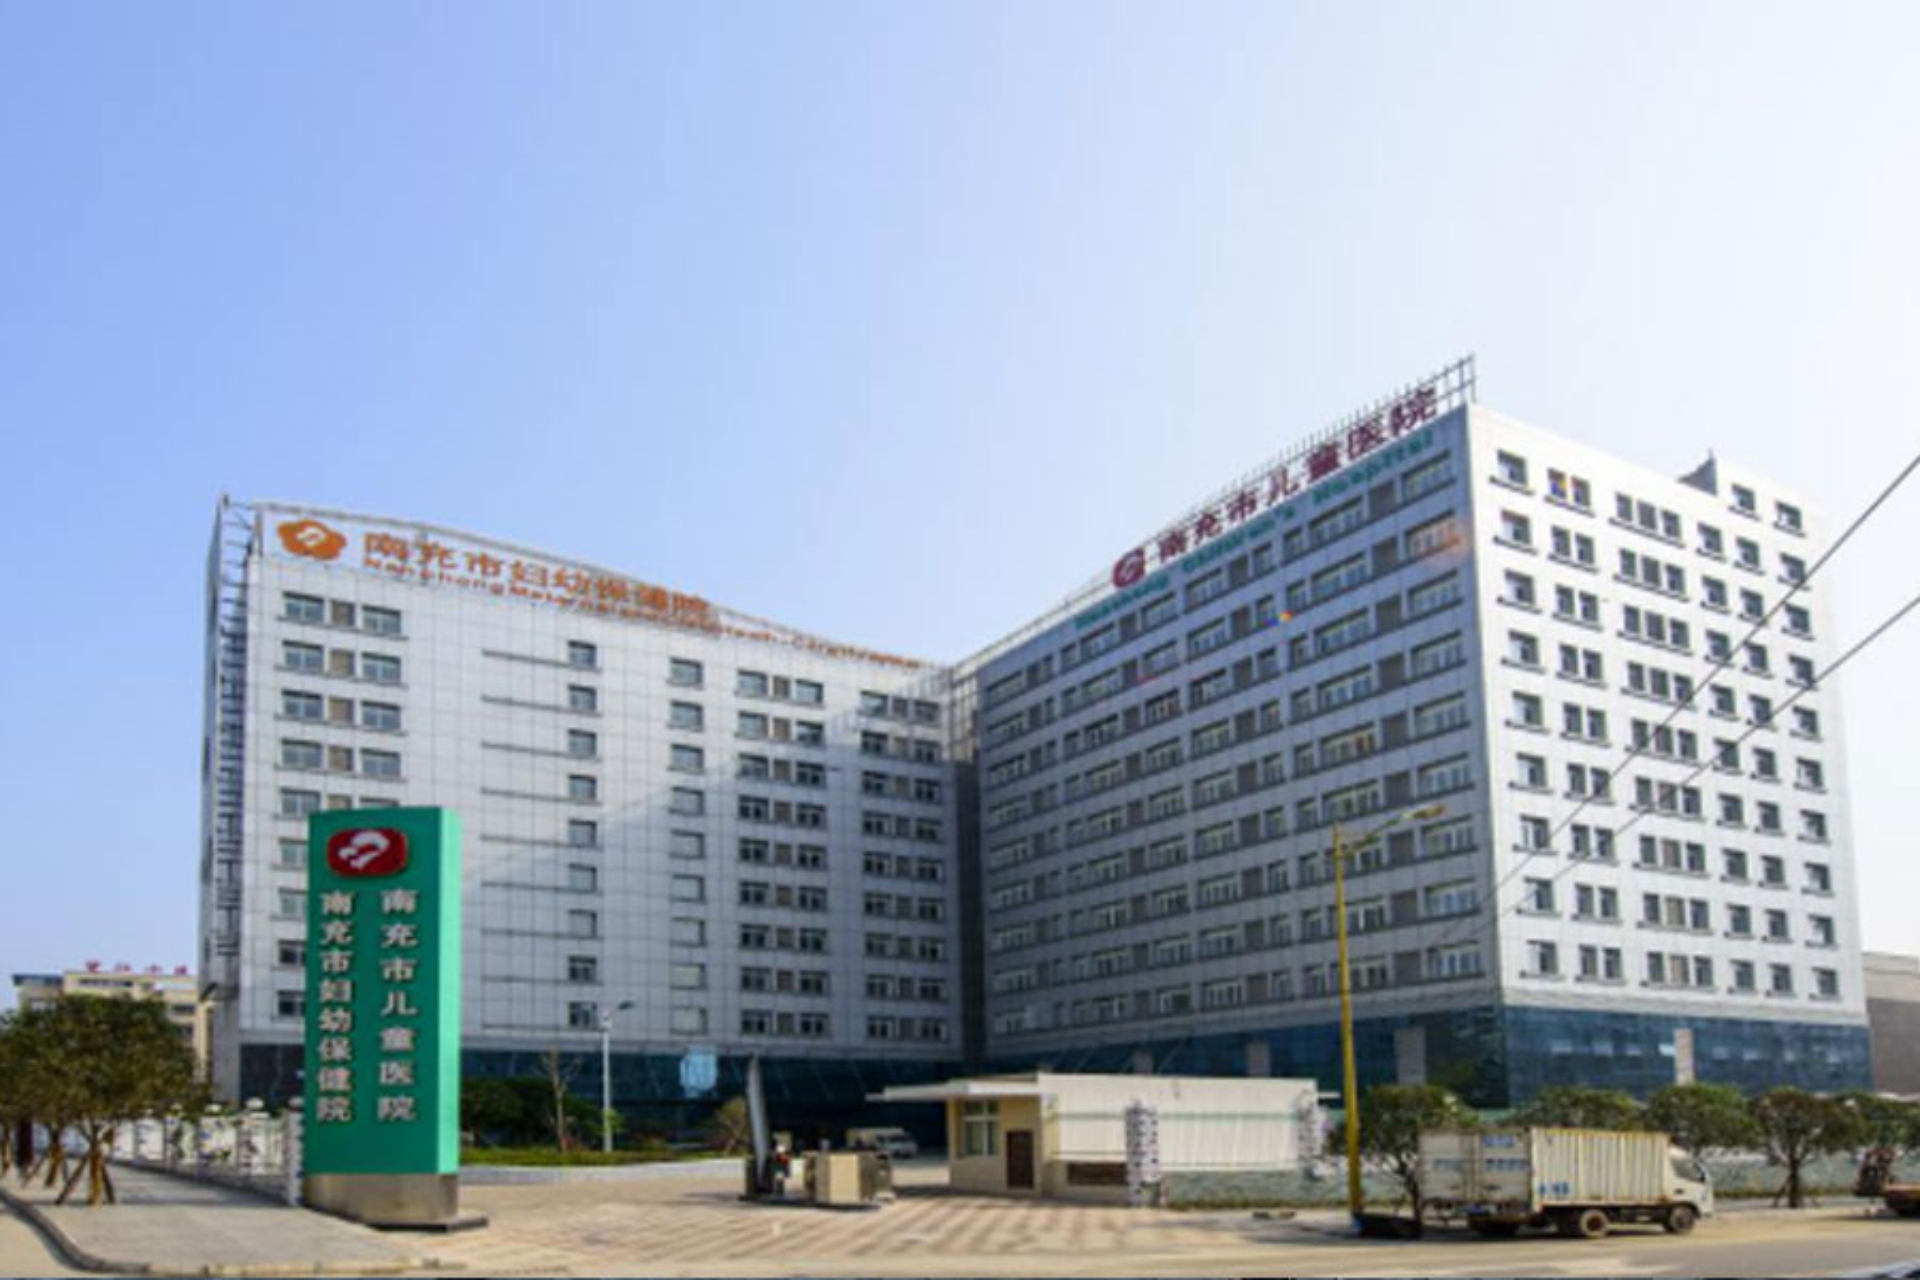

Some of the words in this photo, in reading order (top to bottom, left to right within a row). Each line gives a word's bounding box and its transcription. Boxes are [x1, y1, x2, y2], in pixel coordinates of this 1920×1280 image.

[316, 891, 355, 1123] 南充市妇幼保健院
[377, 888, 419, 1122] 南充市儿童医院
